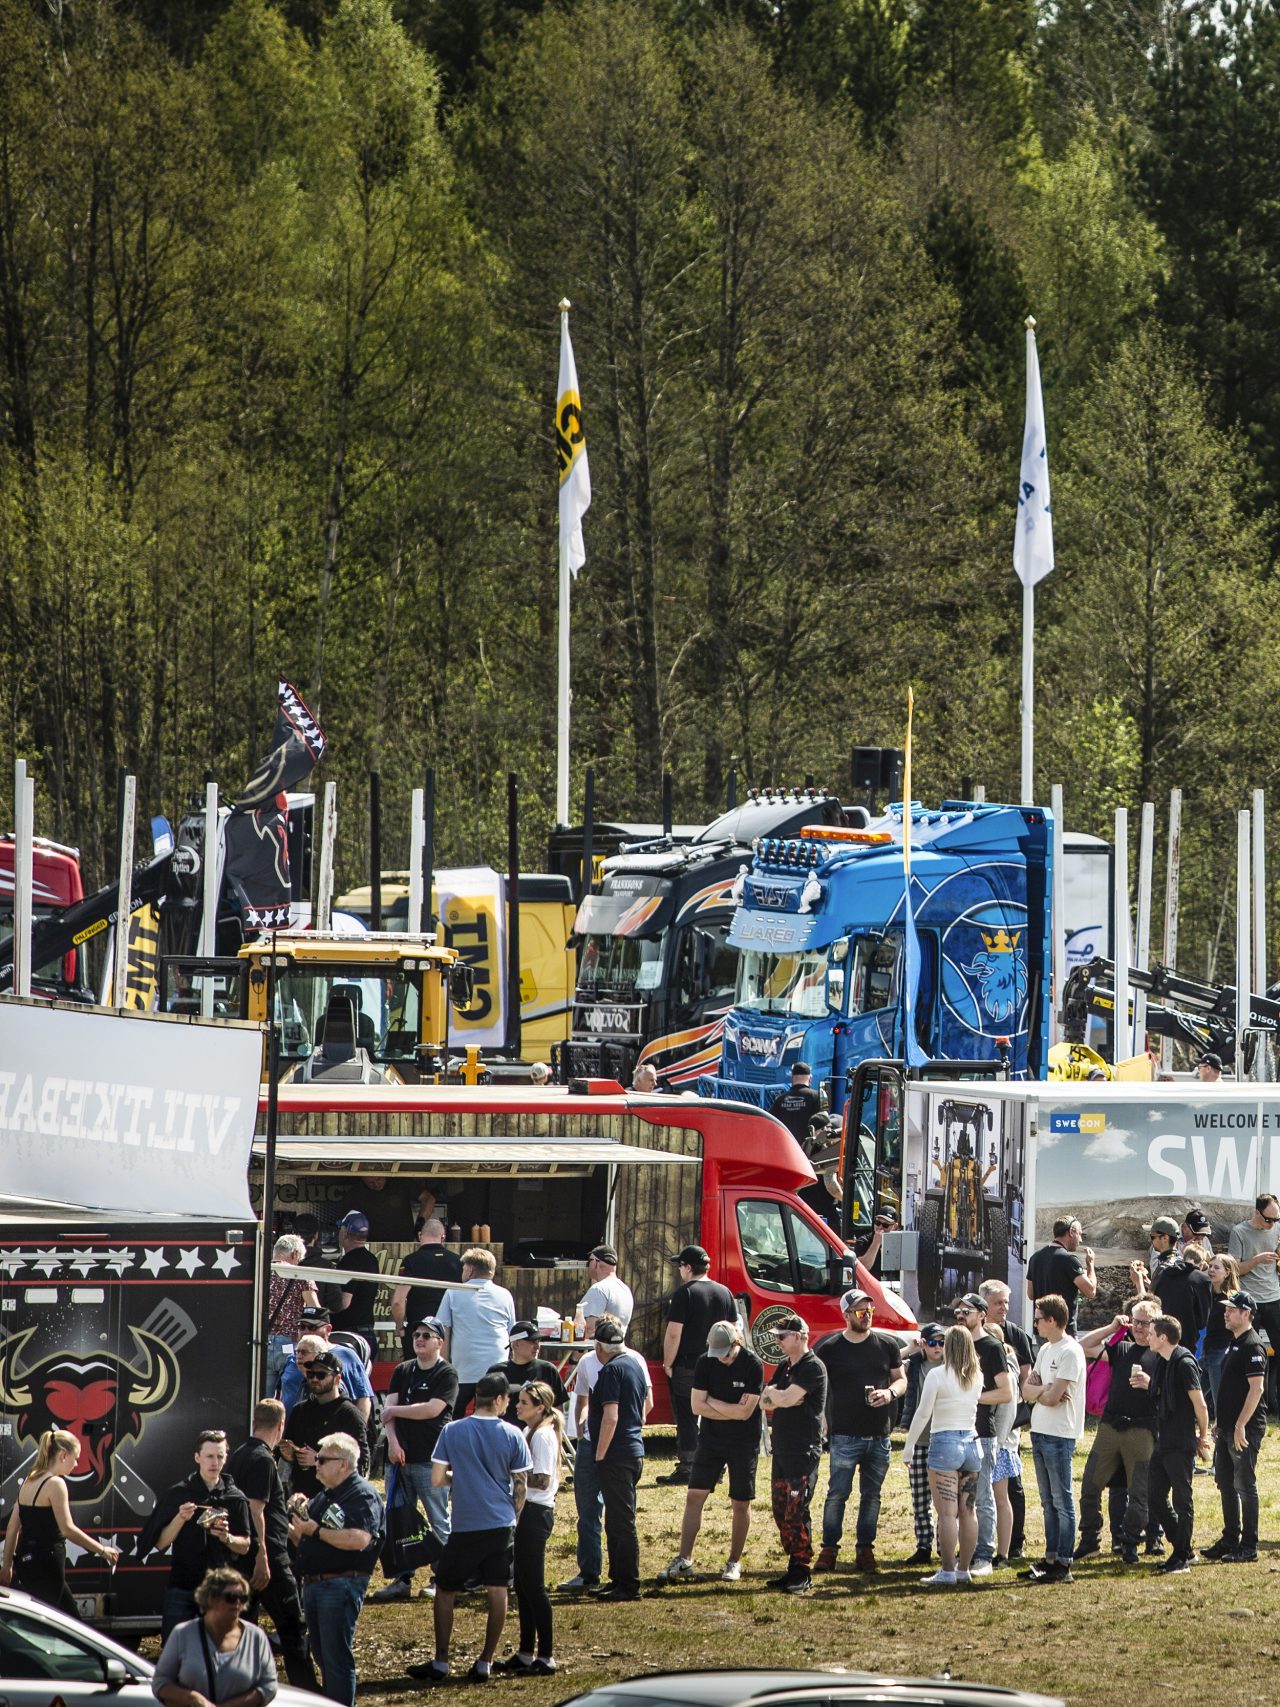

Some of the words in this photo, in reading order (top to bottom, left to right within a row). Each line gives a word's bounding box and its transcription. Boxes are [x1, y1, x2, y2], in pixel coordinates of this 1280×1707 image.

[584, 1012, 623, 1028] VOLVO
[1055, 1119, 1101, 1128] SWECON
[1194, 1114, 1270, 1128] WELCOME
[373, 1302, 392, 1316] the
